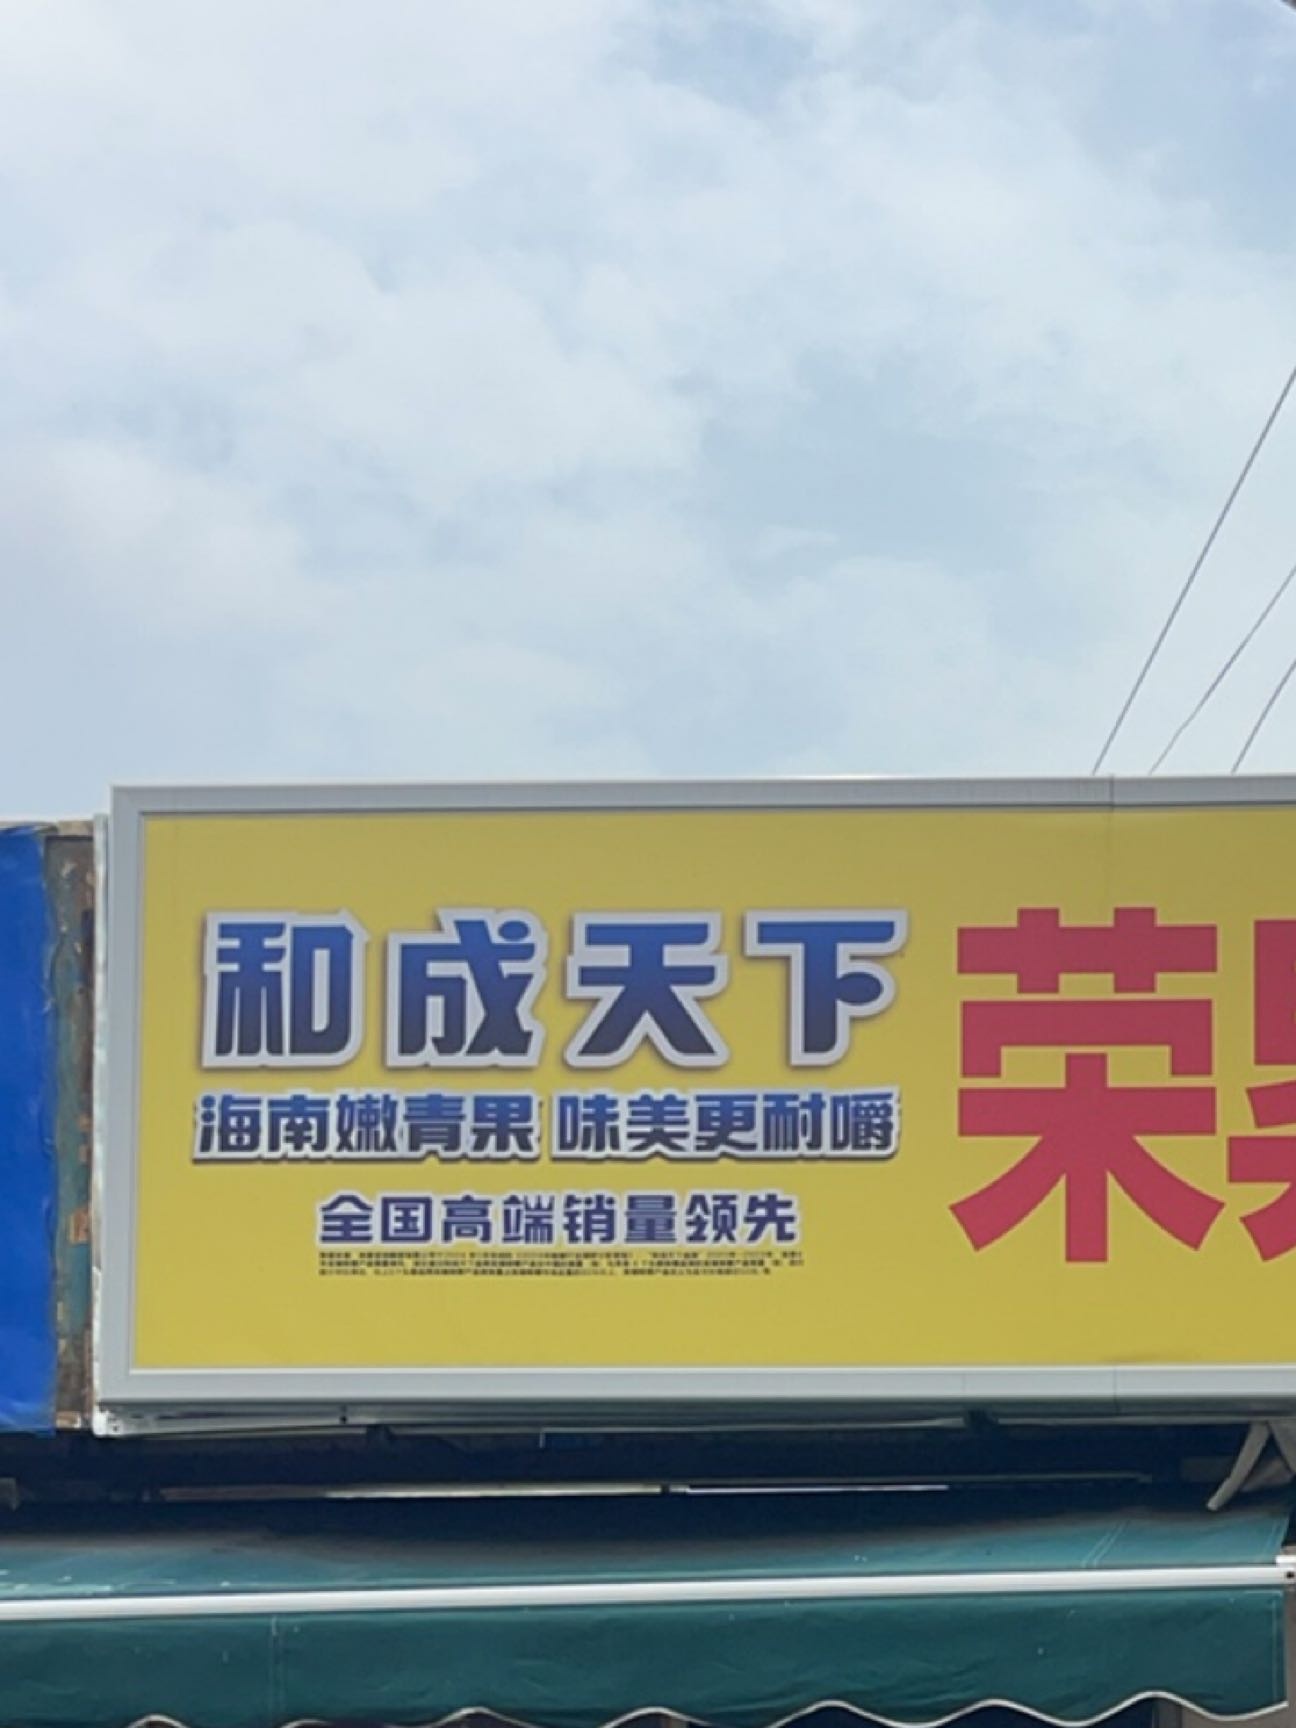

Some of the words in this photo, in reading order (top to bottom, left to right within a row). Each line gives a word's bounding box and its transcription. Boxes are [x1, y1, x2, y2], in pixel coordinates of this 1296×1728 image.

[203, 909, 907, 1069] 和成天下
[194, 1090, 540, 1161] 海南嫩青果
[551, 1089, 899, 1160] 味美更耐嚼
[318, 1192, 801, 1246] 全国高端销量领先
